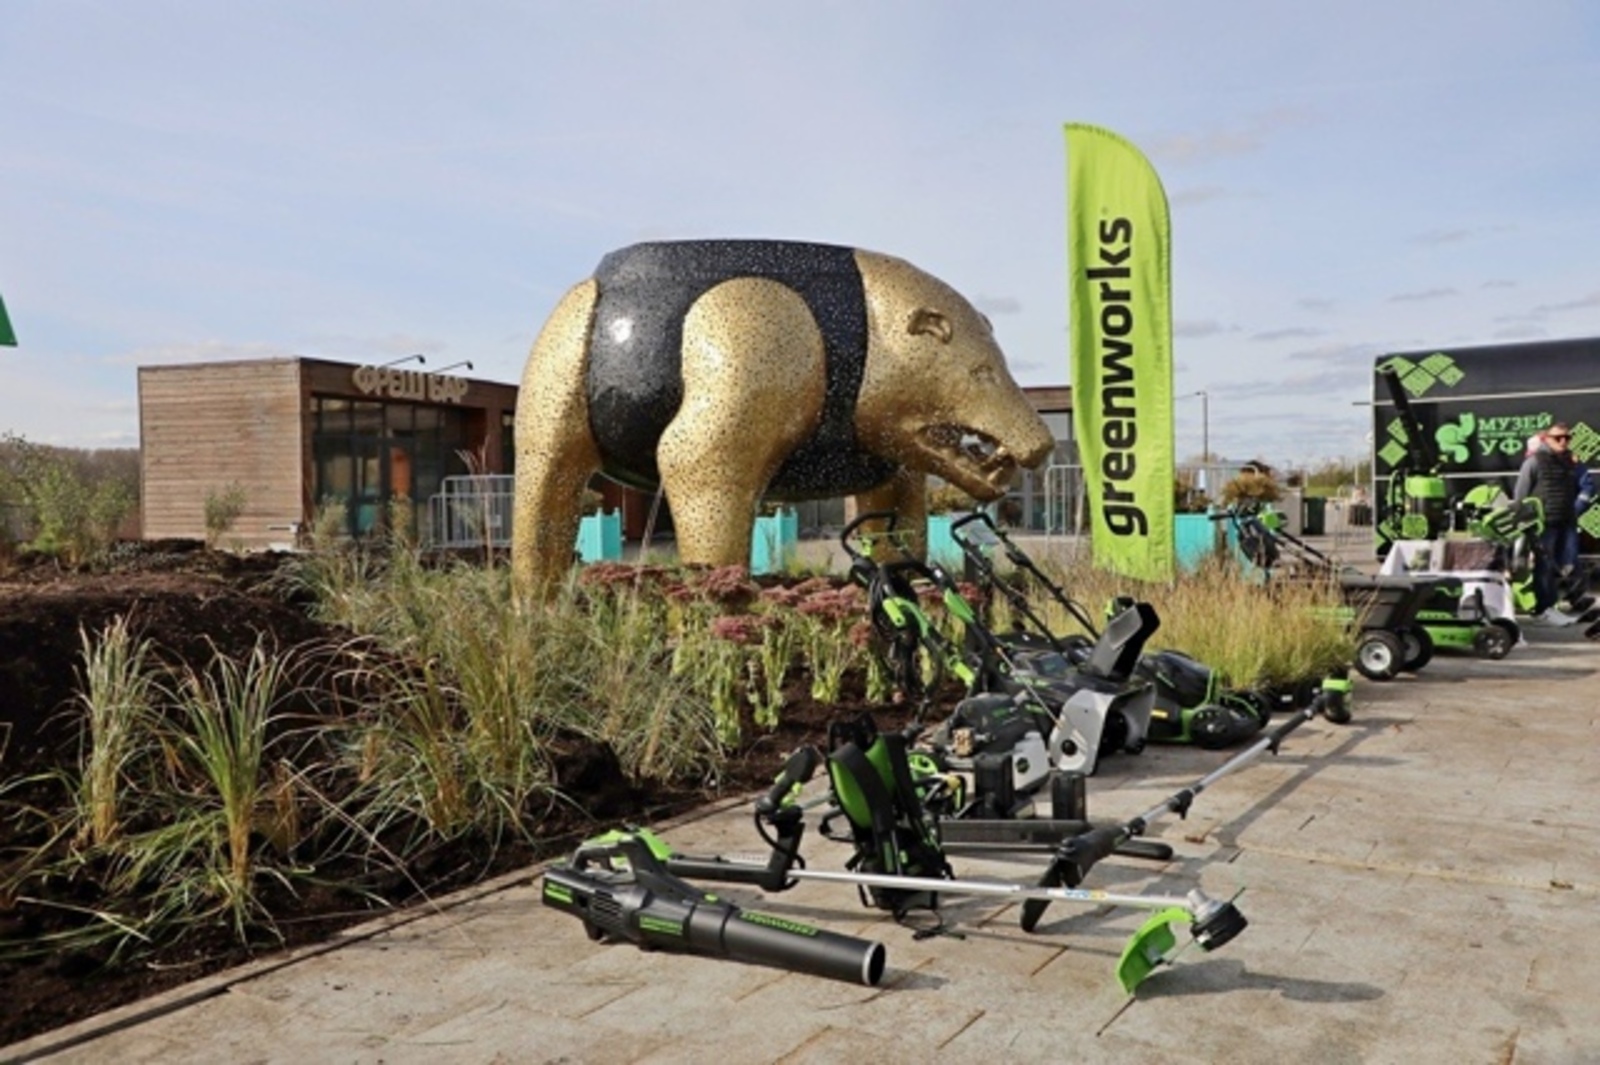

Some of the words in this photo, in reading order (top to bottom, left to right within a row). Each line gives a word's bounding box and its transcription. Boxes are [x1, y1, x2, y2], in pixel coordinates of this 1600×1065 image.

[352, 364, 425, 400] ФРЕШ
[427, 374, 468, 403] БАР
[1086, 217, 1148, 537] greenworks
[1478, 412, 1553, 431] МУЗЕЙ
[1478, 436, 1524, 456] УФ
